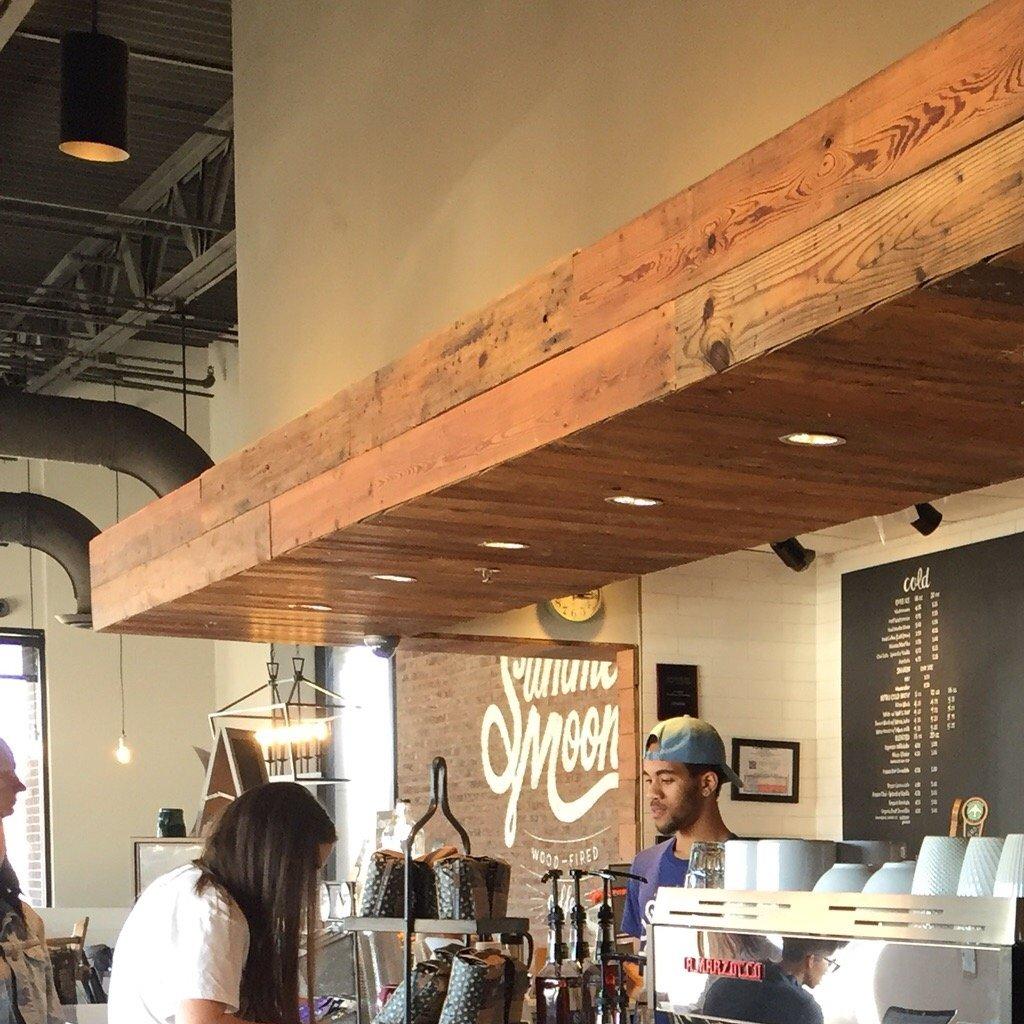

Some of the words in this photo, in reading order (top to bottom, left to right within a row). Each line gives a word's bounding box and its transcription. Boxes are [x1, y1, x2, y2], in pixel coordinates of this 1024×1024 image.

[903, 567, 931, 592] cold
[481, 703, 619, 848] Moon
[531, 846, 599, 869] WOOD-FIRED
